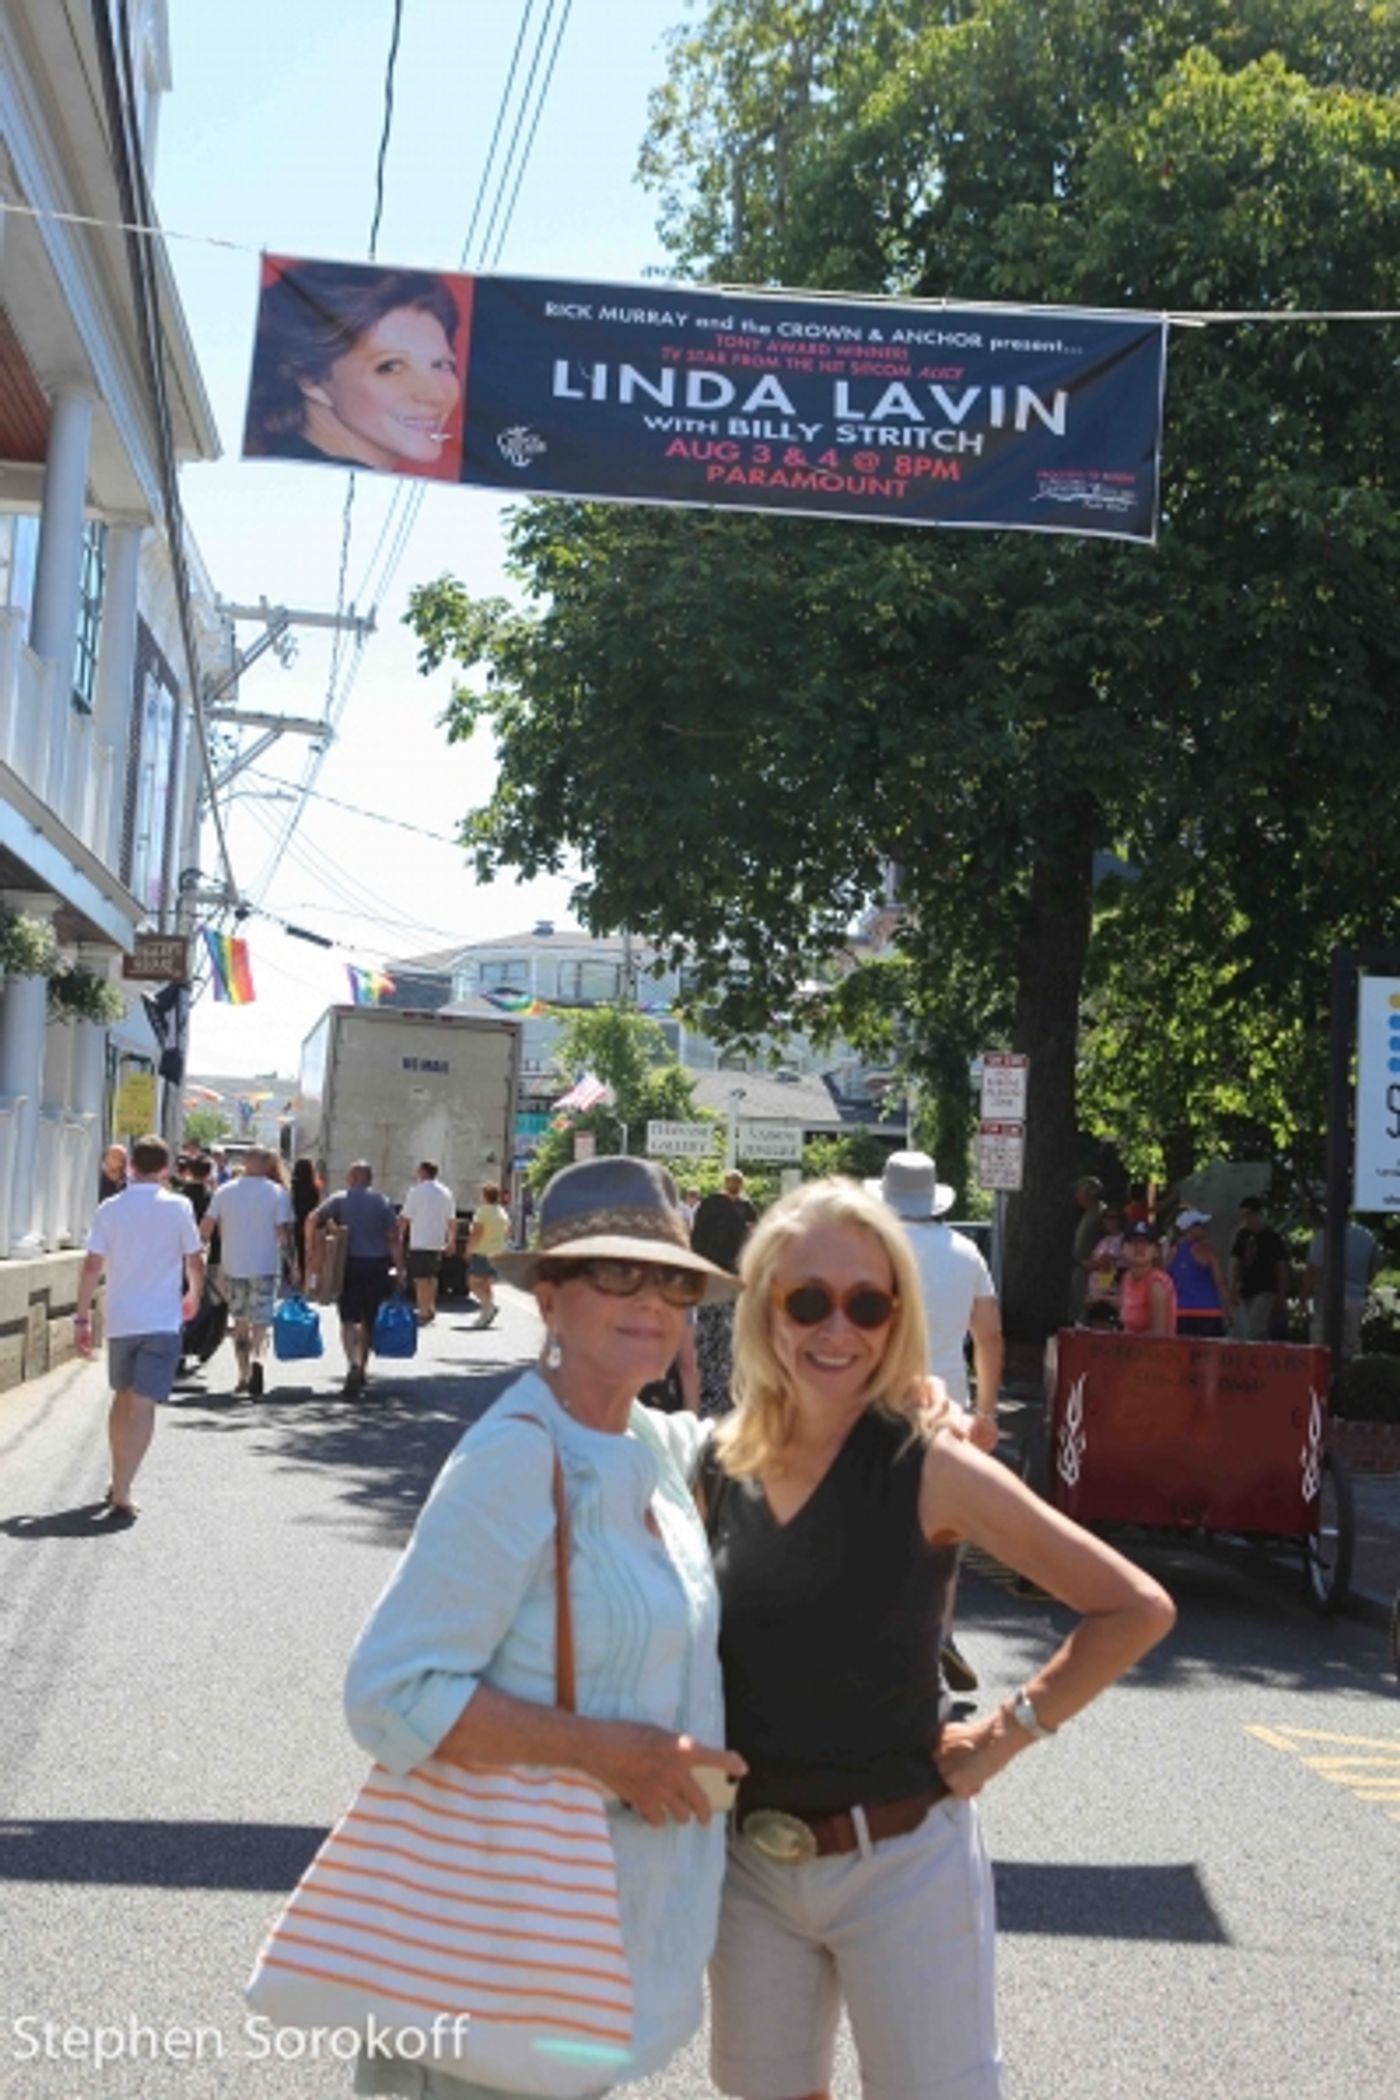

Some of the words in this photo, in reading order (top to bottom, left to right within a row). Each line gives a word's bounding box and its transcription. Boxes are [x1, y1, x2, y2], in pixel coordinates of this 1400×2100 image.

[544, 301, 593, 320] RICK
[598, 306, 688, 328] MURRAY
[696, 316, 733, 331] and
[741, 319, 771, 335] the
[777, 321, 862, 342] CROWN
[868, 328, 883, 343] &
[892, 328, 982, 348] ANCHOR
[715, 334, 760, 350] TONY
[766, 338, 830, 355] AWARD
[660, 346, 681, 361] TV
[686, 348, 726, 365] STAR
[732, 351, 780, 369] FROM
[786, 355, 814, 372] THE
[820, 359, 844, 374] HIT
[851, 362, 911, 378] SITCOM
[917, 366, 966, 380] ALICE
[553, 359, 796, 415] LINDA
[834, 380, 1068, 436] LAVIN
[643, 414, 719, 435] WITH
[728, 416, 823, 443] BILLY
[836, 424, 984, 457] STRITCH
[665, 437, 740, 463] AUG
[752, 444, 771, 464] 3
[783, 446, 808, 467] &
[819, 448, 838, 470] 4
[853, 451, 880, 473] @
[894, 454, 961, 481] 8PM
[707, 464, 908, 498] PARAMOUNT
